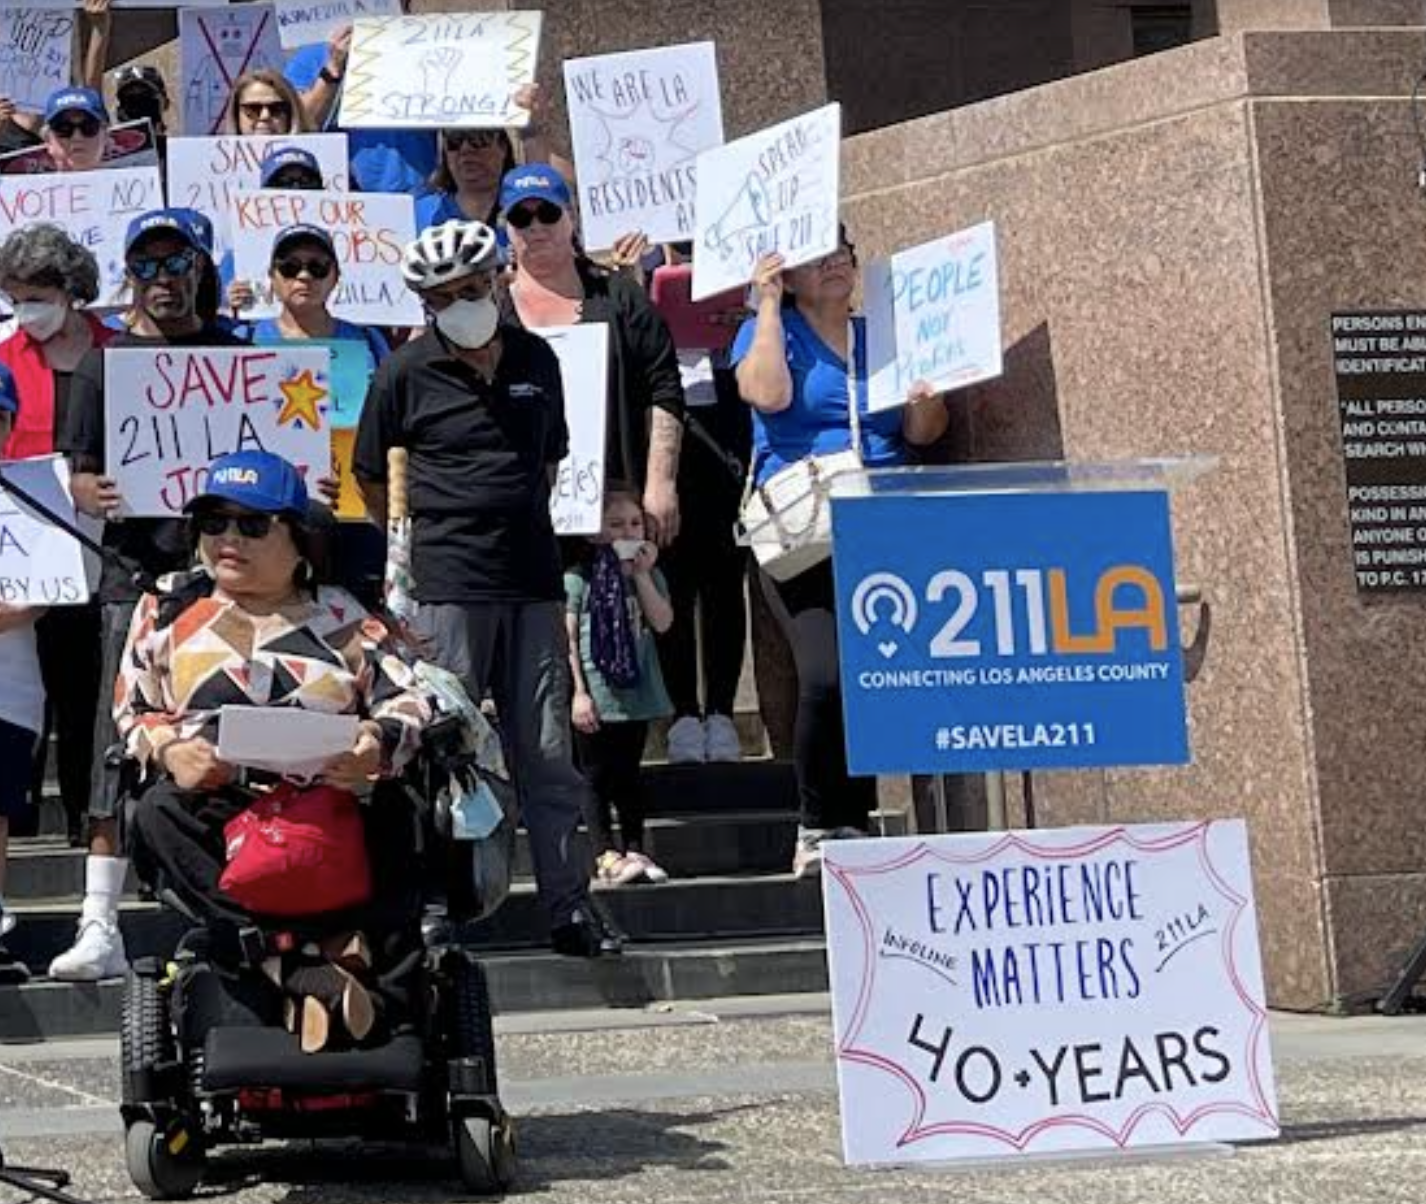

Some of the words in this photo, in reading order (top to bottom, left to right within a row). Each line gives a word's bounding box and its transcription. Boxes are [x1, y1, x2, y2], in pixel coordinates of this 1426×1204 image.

[570, 70, 606, 102] WE
[613, 69, 651, 107] ARE
[659, 74, 688, 107] LA
[234, 196, 307, 230] KEEP
[319, 199, 366, 227] OUR
[332, 228, 404, 267] OBS
[883, 251, 986, 312] PEOPLE
[1332, 316, 1406, 332] PERSONS
[1334, 337, 1376, 352] MUST
[1378, 336, 1400, 352] BE
[145, 352, 278, 410] SAVE
[1342, 421, 1375, 437] AND
[1344, 441, 1406, 459] SEARCH
[1351, 506, 1388, 521] KIND
[1389, 506, 1407, 521] IN
[1354, 527, 1415, 543] ANYONE
[1354, 550, 1371, 565] IS
[41, 575, 81, 602] US
[1356, 571, 1379, 587] TO
[859, 668, 976, 690] CONNECTING
[978, 667, 1013, 686] LOS
[1015, 665, 1096, 684] ANGELES
[1098, 662, 1171, 683] COUNTY
[934, 721, 1096, 751] #SAVELA211
[970, 937, 1141, 1009] MATTERS
